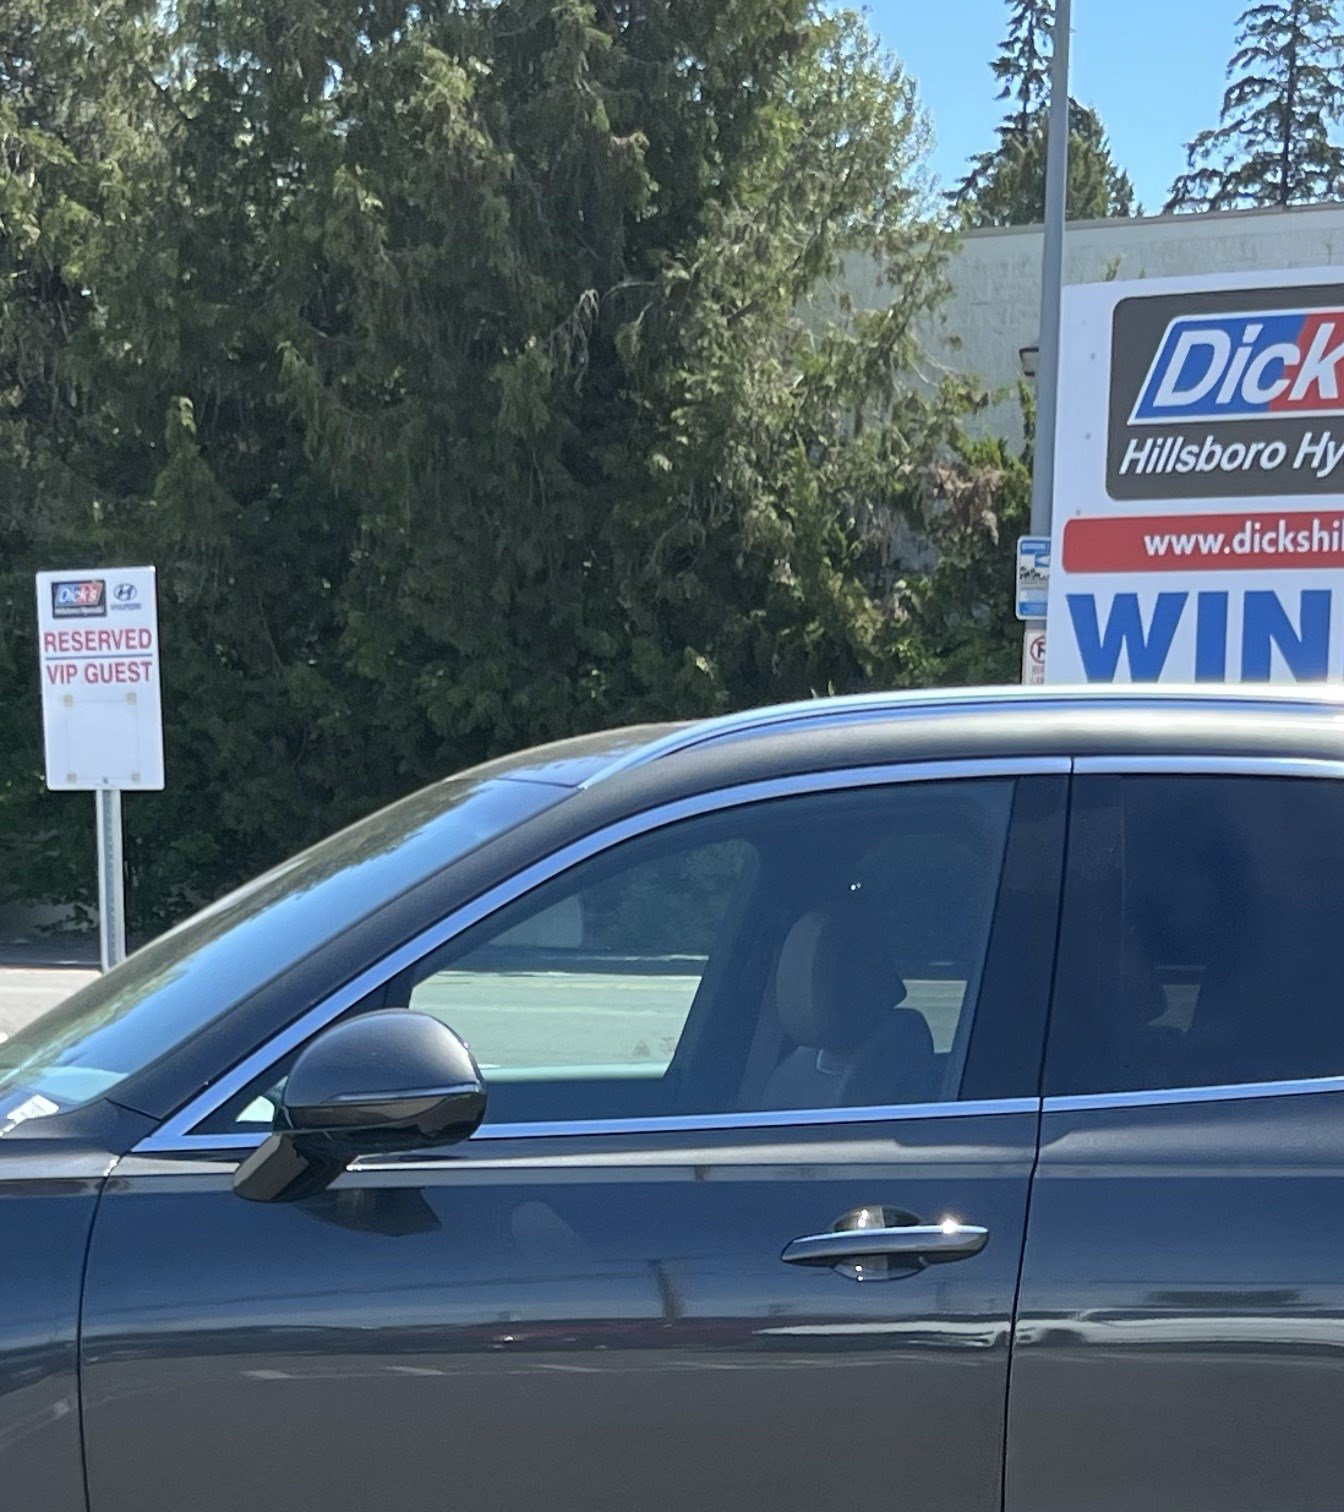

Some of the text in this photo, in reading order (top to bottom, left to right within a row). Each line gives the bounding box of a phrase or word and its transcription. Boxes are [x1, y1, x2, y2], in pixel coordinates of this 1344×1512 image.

[1119, 435, 1287, 475] Hillsboro
[44, 628, 152, 653] RESERVED
[46, 661, 153, 685] VIP GUEST
